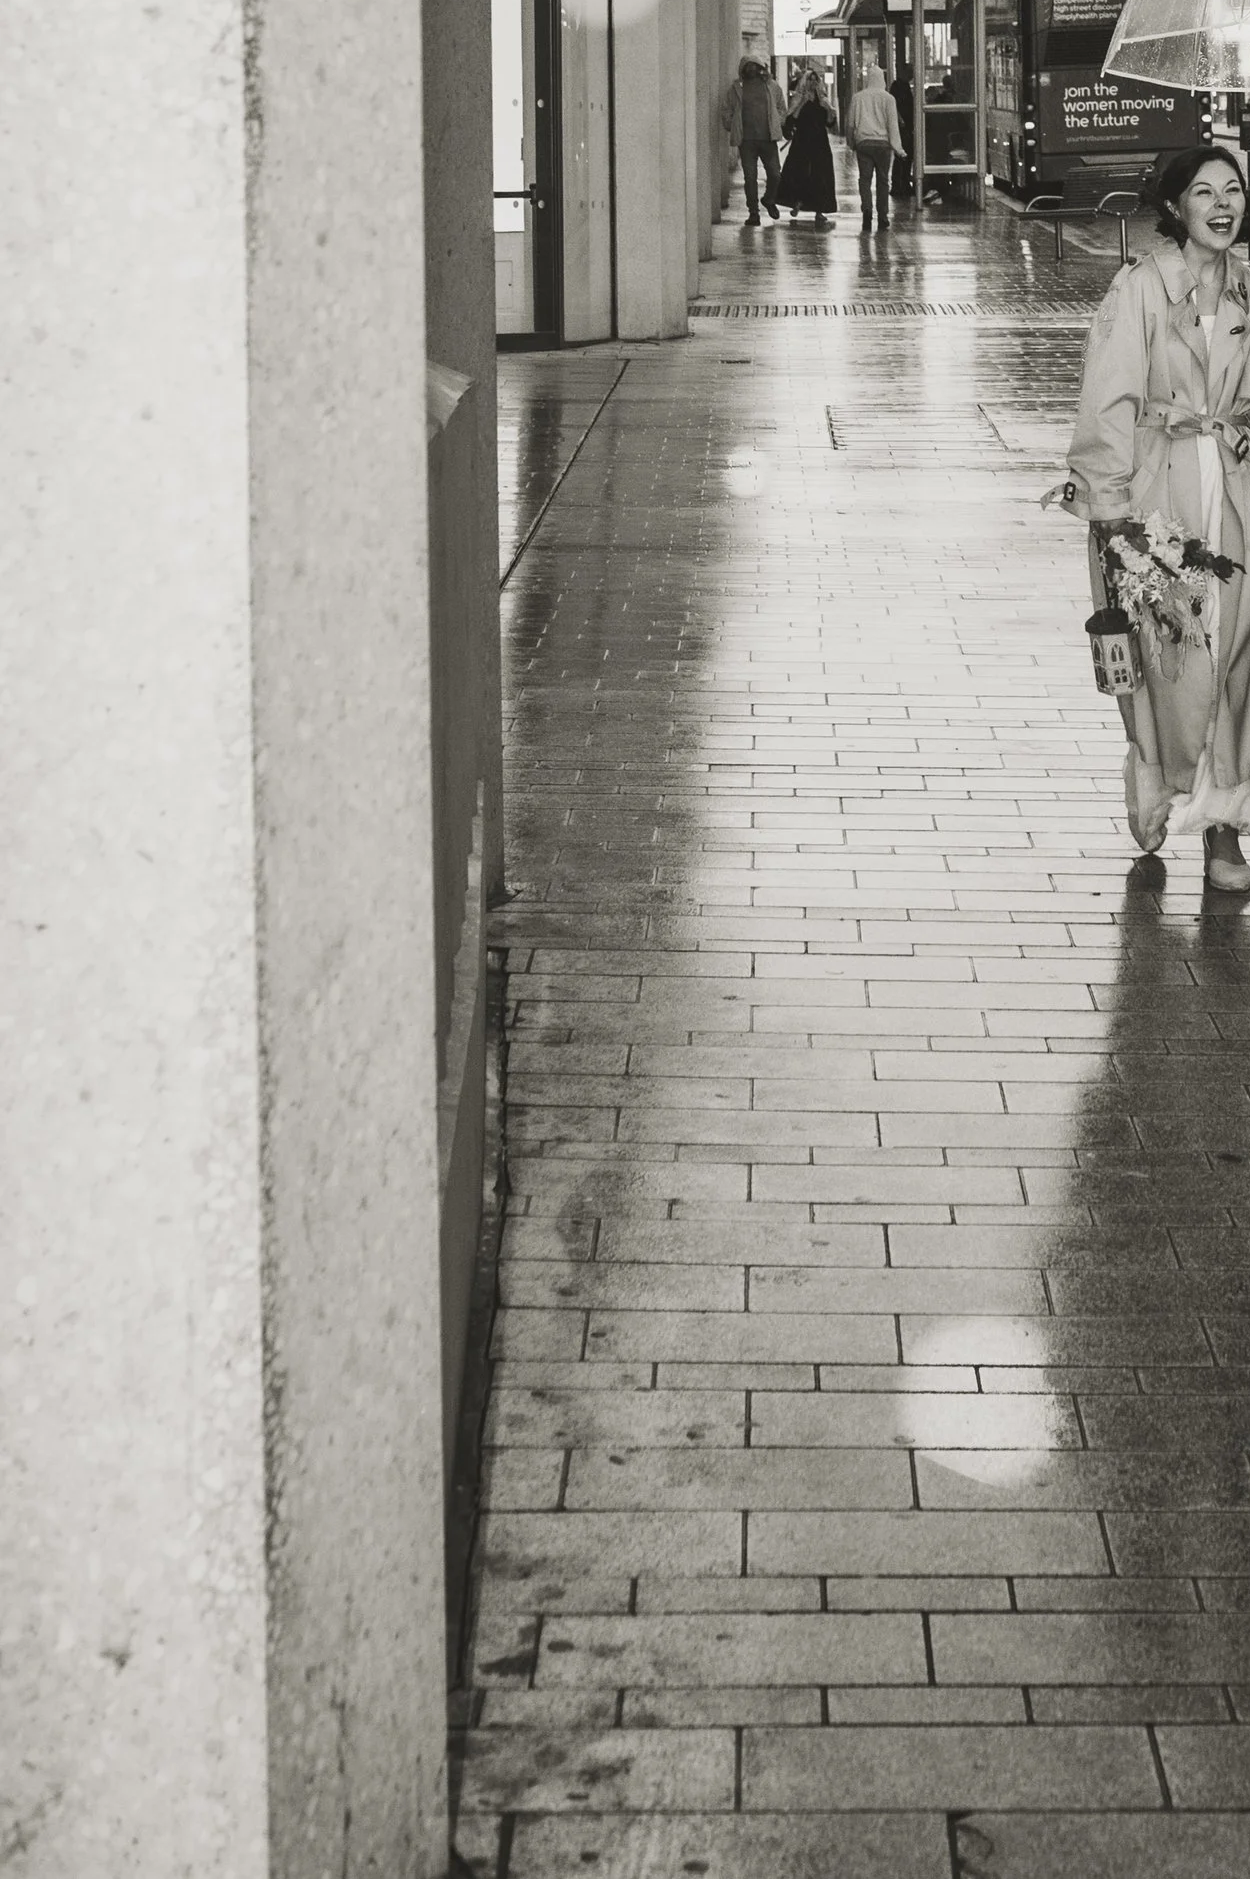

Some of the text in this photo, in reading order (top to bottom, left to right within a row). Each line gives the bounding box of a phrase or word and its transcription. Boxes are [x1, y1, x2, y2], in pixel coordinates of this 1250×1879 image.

[1053, 4, 1069, 14] high
[1070, 3, 1092, 12] street
[1099, 11, 1118, 20] plans
[1063, 83, 1119, 100] join the
[1063, 95, 1175, 113] women moving
[1064, 113, 1140, 128] the future
